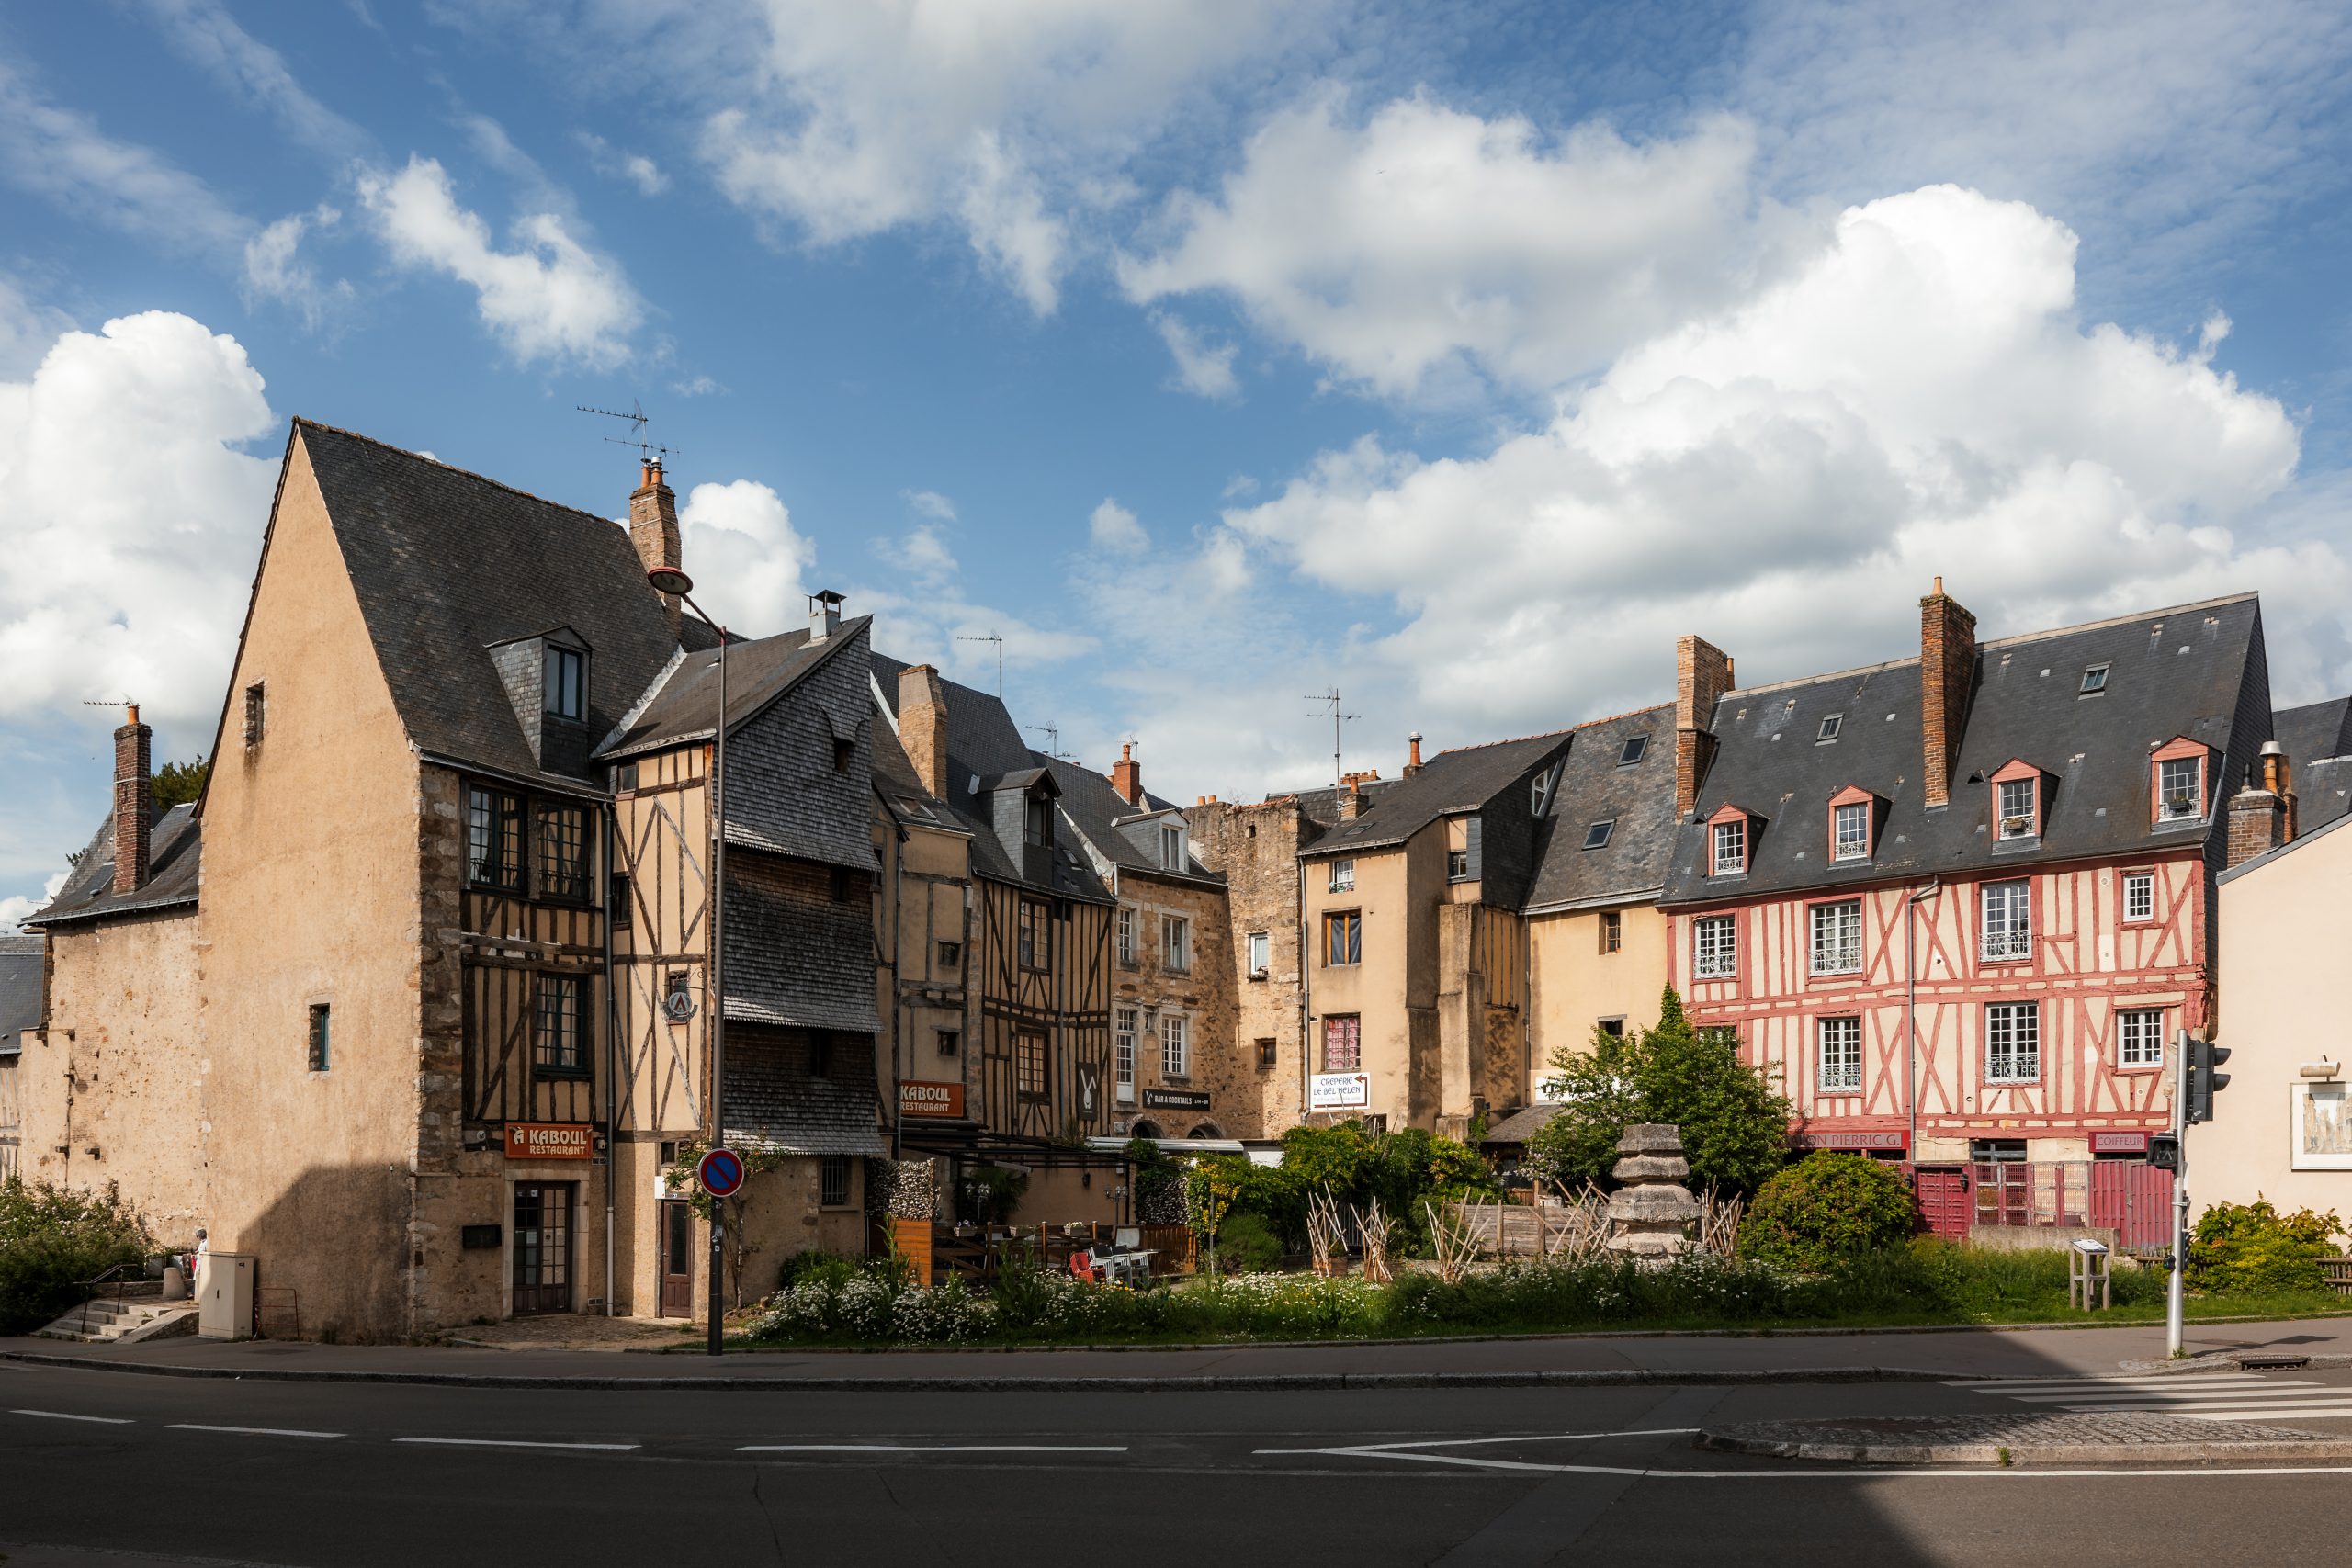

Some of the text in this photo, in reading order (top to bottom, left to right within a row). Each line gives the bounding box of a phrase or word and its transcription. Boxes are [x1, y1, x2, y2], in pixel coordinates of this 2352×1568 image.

[1320, 1077, 1352, 1086] CREPERIE
[900, 1085, 951, 1101] KABOUL
[1154, 1095, 1164, 1103] BAR
[1168, 1096, 1193, 1105] COCKTAILS
[900, 1102, 950, 1112] RESTAURANT
[514, 1126, 587, 1145] À KABOUL
[1784, 1134, 1900, 1146] AON PIERRIC G.
[2097, 1136, 2143, 1145] COIFFEUR
[529, 1145, 585, 1156] RESTAURANT
